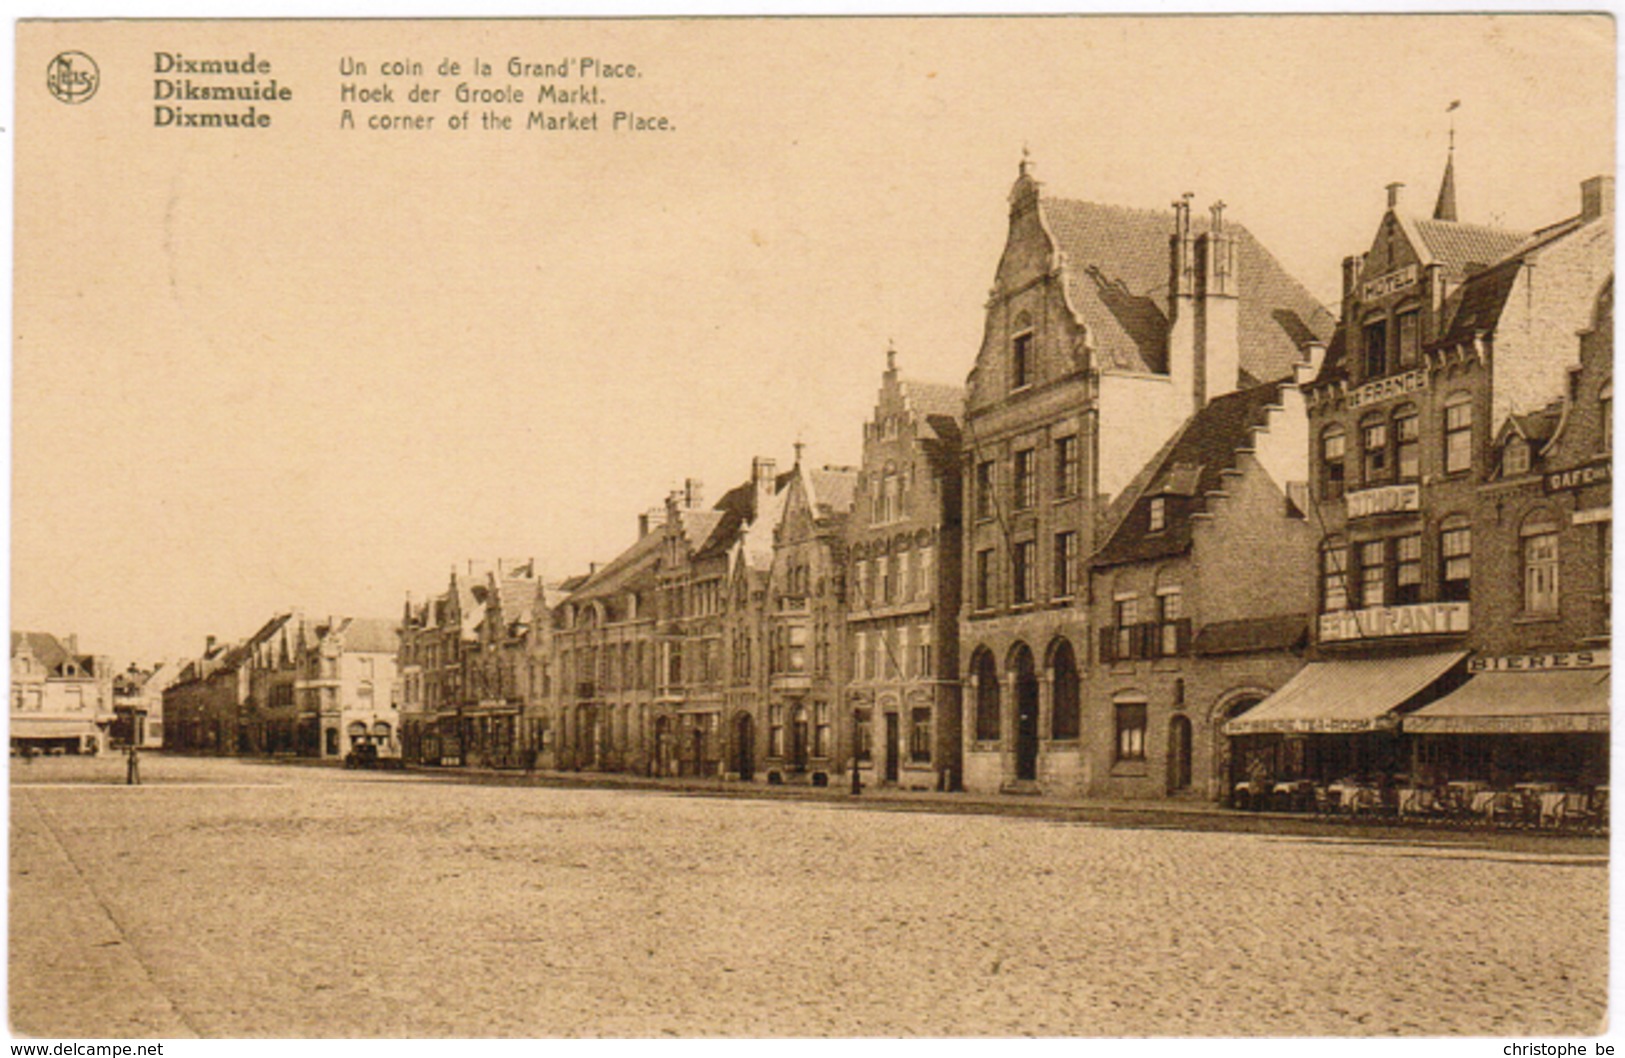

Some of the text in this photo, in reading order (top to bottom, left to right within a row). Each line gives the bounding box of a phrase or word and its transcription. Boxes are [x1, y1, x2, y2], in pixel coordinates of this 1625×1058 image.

[155, 53, 270, 74] Dixmude
[340, 57, 367, 77] Un
[381, 59, 423, 76] coin
[438, 58, 461, 76] de
[475, 57, 492, 77] la
[155, 80, 292, 101] Diksmuide
[341, 83, 394, 103] Hoek
[408, 83, 441, 103] der
[538, 84, 606, 105] Markt.
[155, 106, 270, 127] Dixmude
[341, 109, 676, 131] A corner of the Market Place.
[1364, 268, 1415, 300] HOTEL
[1364, 371, 1425, 399] FRANCE
[1471, 652, 1594, 671] BIERES
